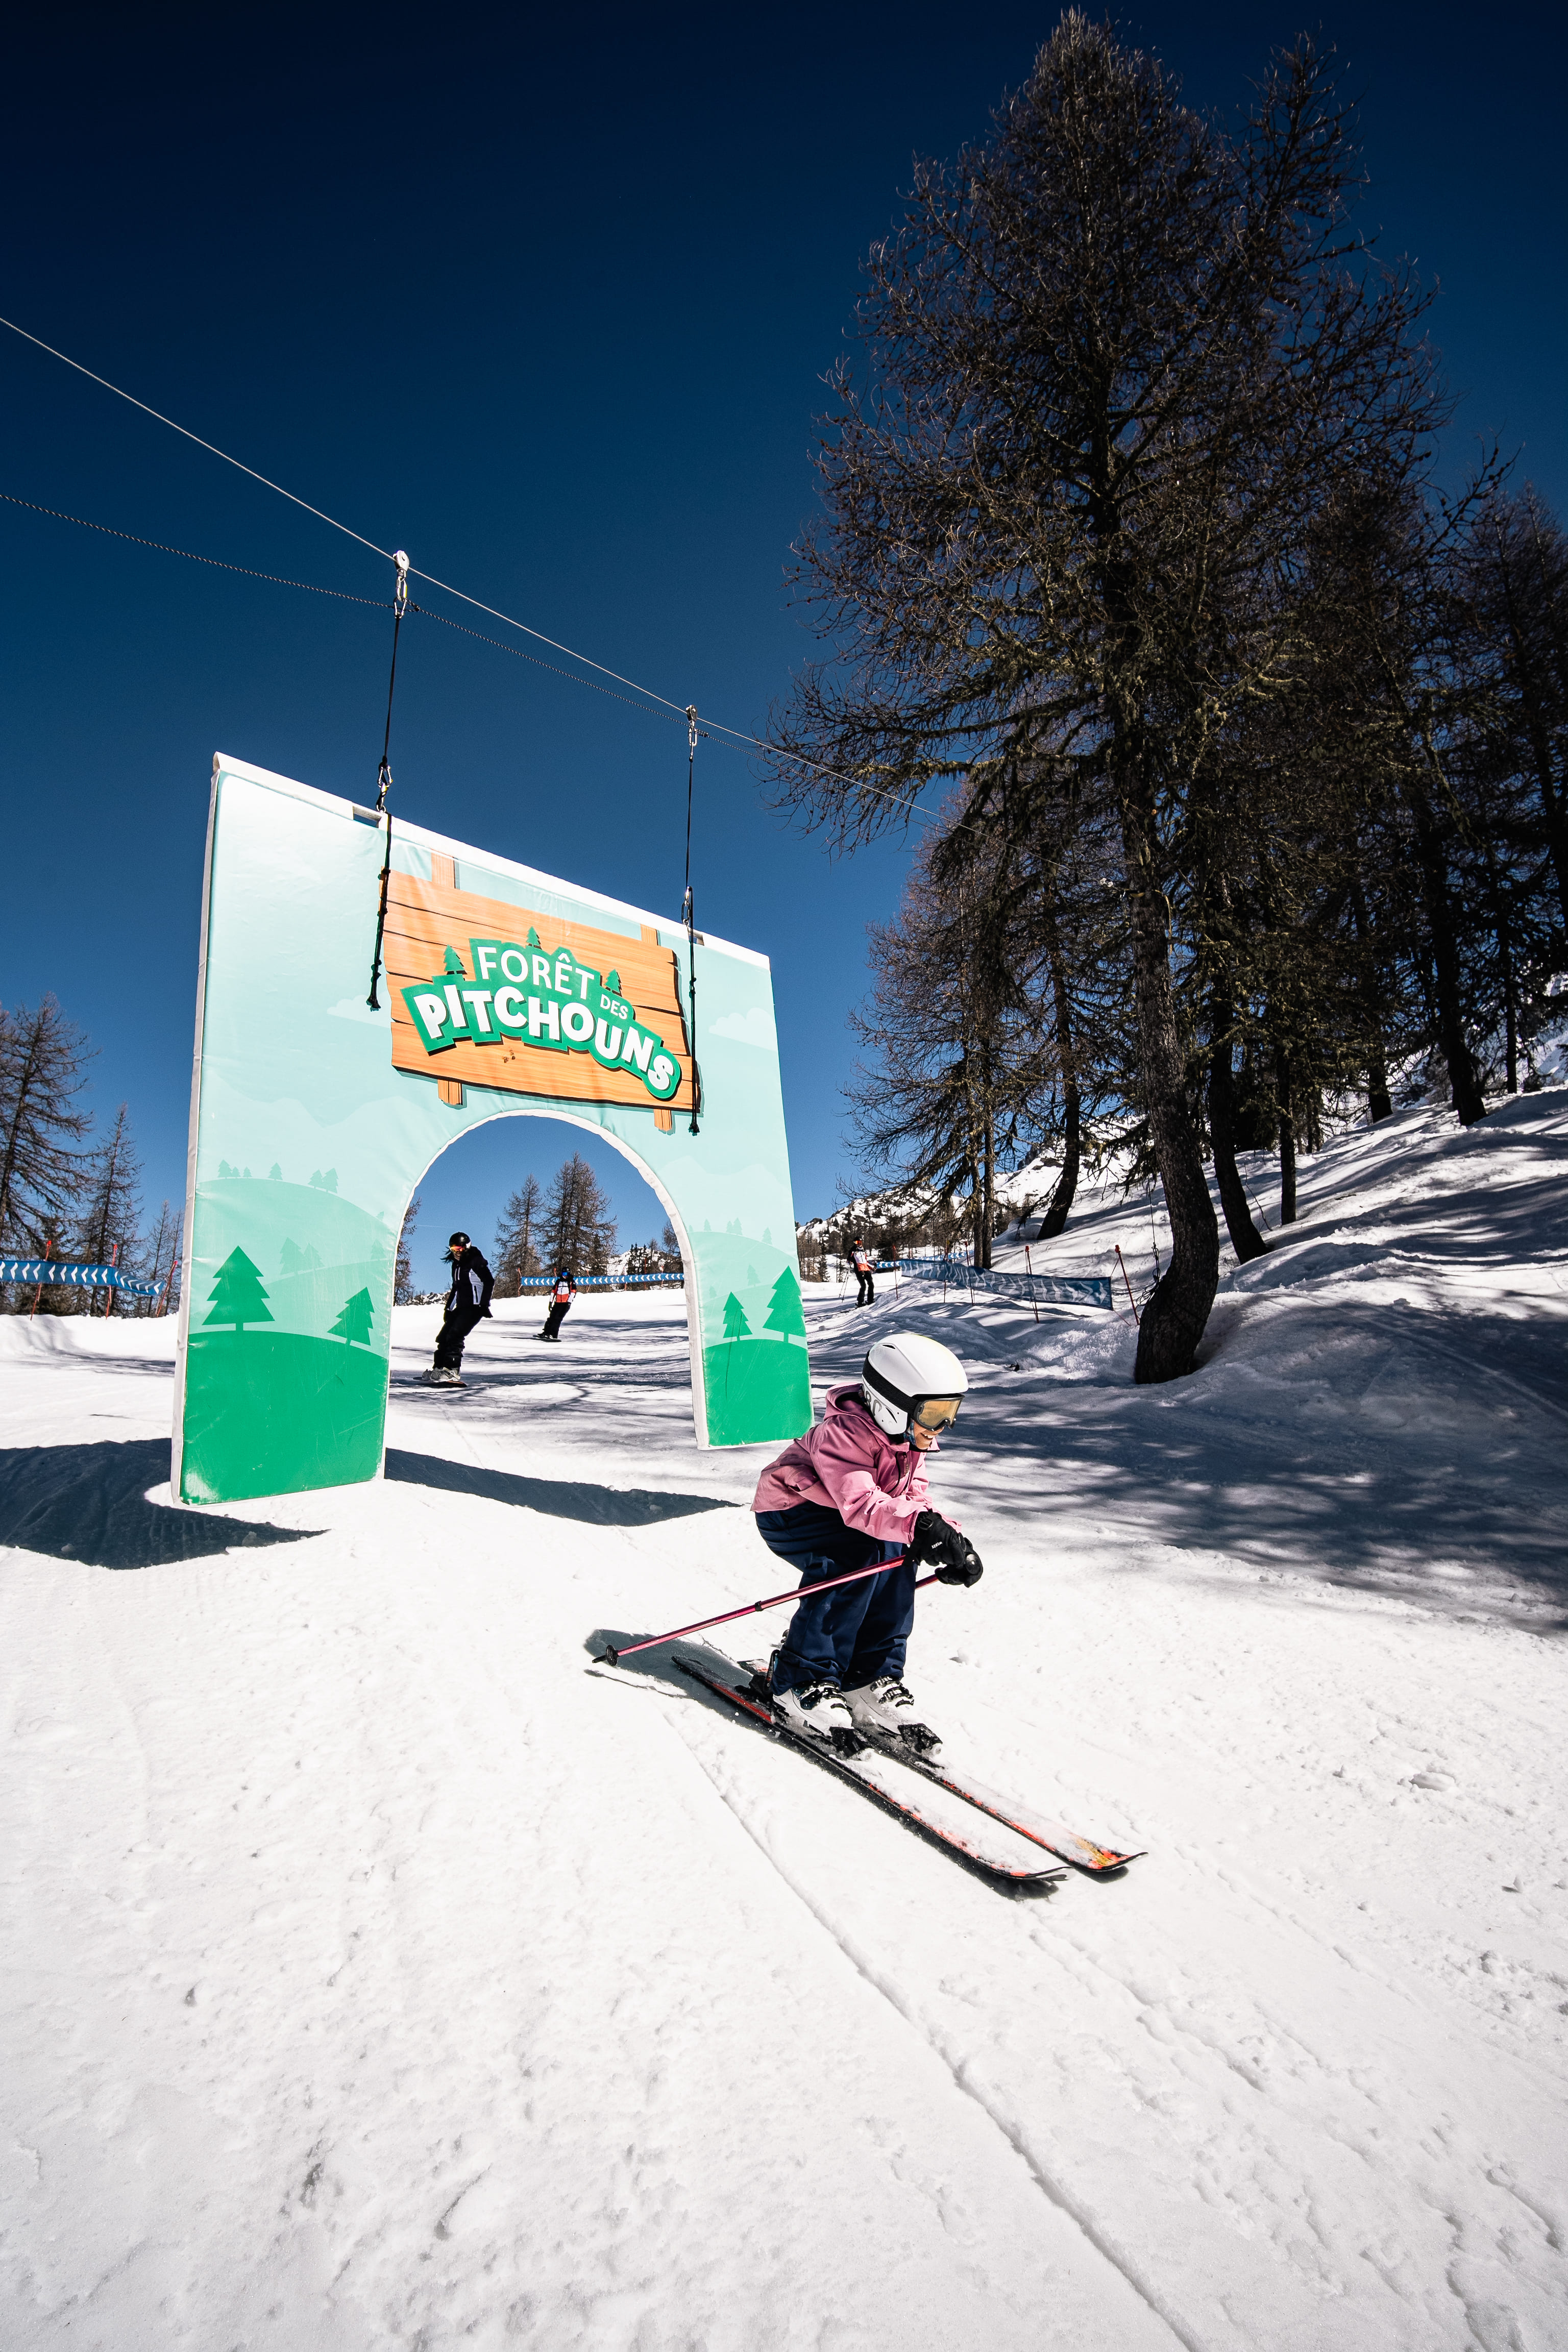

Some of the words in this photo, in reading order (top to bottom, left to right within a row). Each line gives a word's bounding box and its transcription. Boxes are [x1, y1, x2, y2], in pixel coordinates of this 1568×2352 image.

[477, 946, 595, 1000] FORÊT
[599, 993, 628, 1020] DES
[413, 984, 675, 1091] PITCHOUNS
